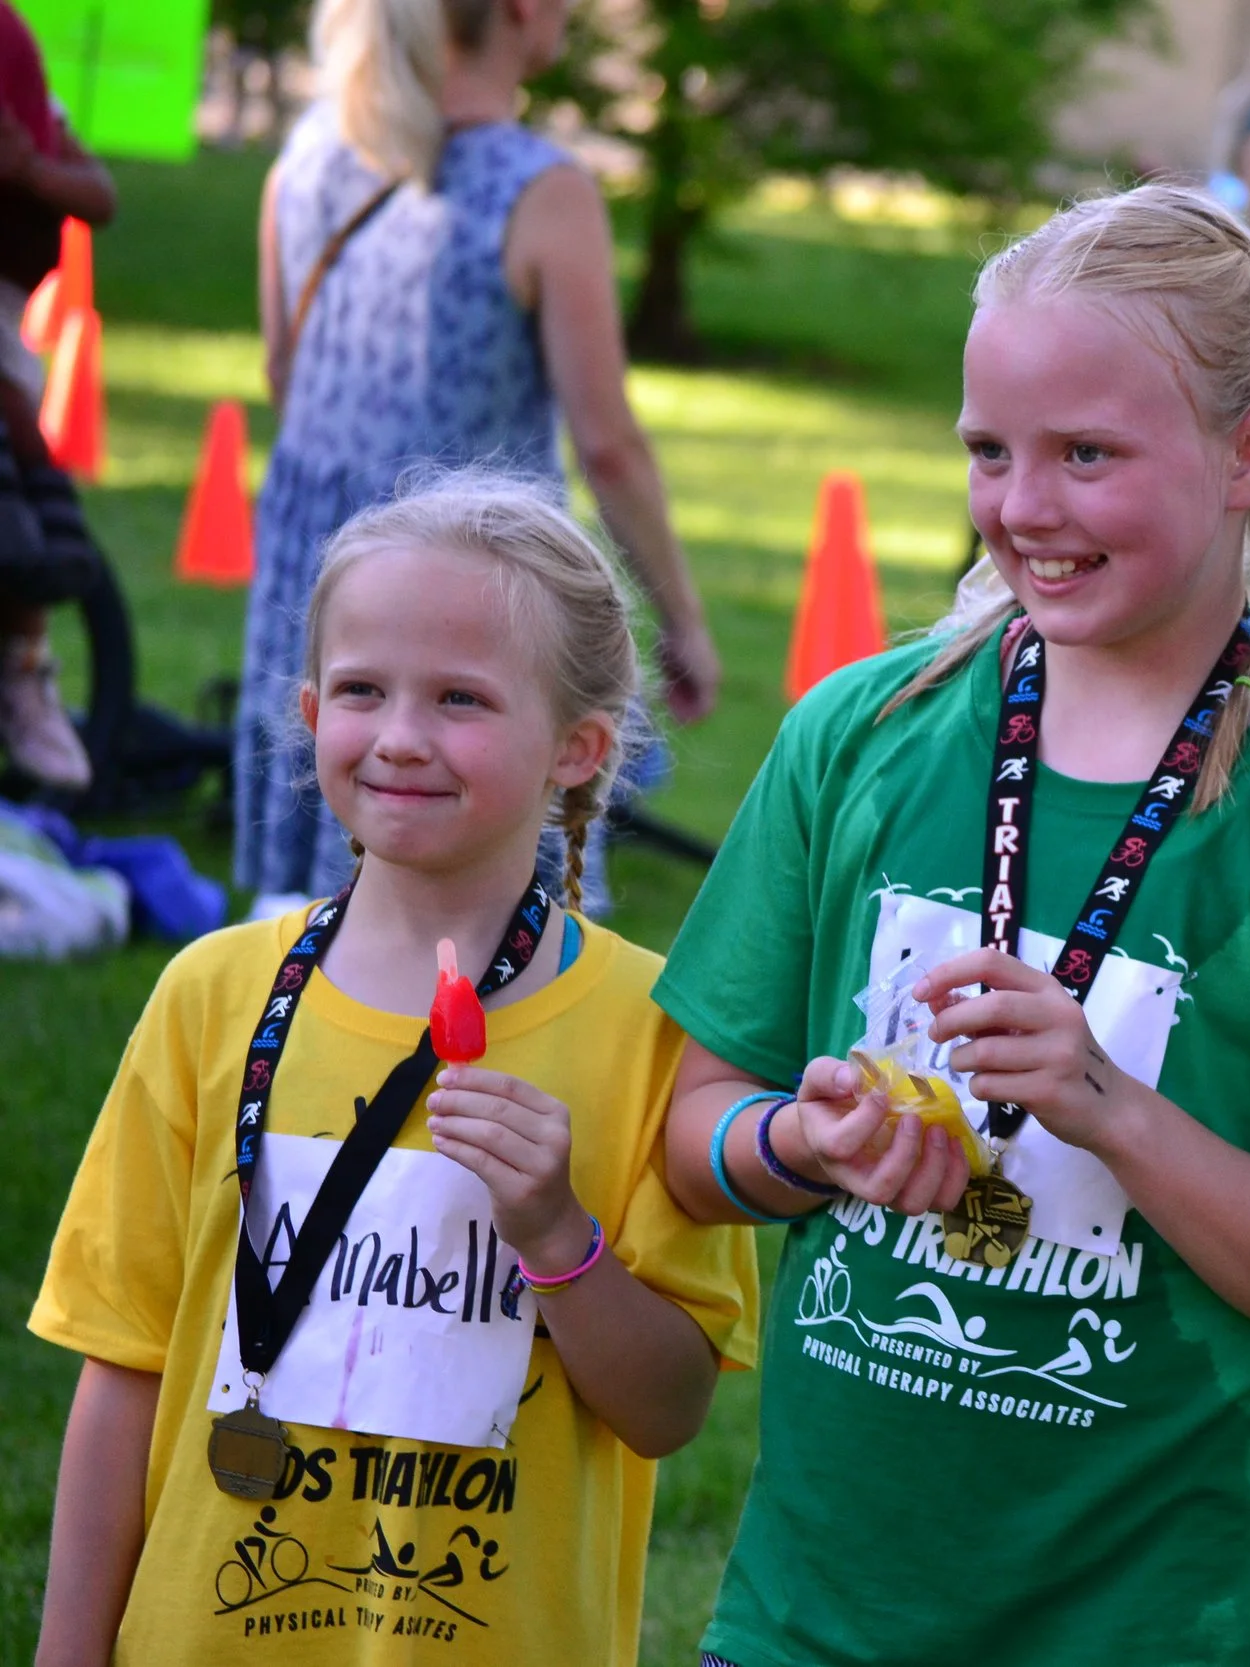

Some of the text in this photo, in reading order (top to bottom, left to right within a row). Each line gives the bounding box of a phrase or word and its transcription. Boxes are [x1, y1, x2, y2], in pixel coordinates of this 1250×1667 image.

[892, 1211, 1143, 1300] TRHLON
[871, 1333, 982, 1376] PRESENTED BY
[802, 1335, 1096, 1428] PHYSICAL THERAPY ASSOCIATES
[392, 1586, 411, 1602] BY
[244, 1606, 347, 1637] PHYSICAL
